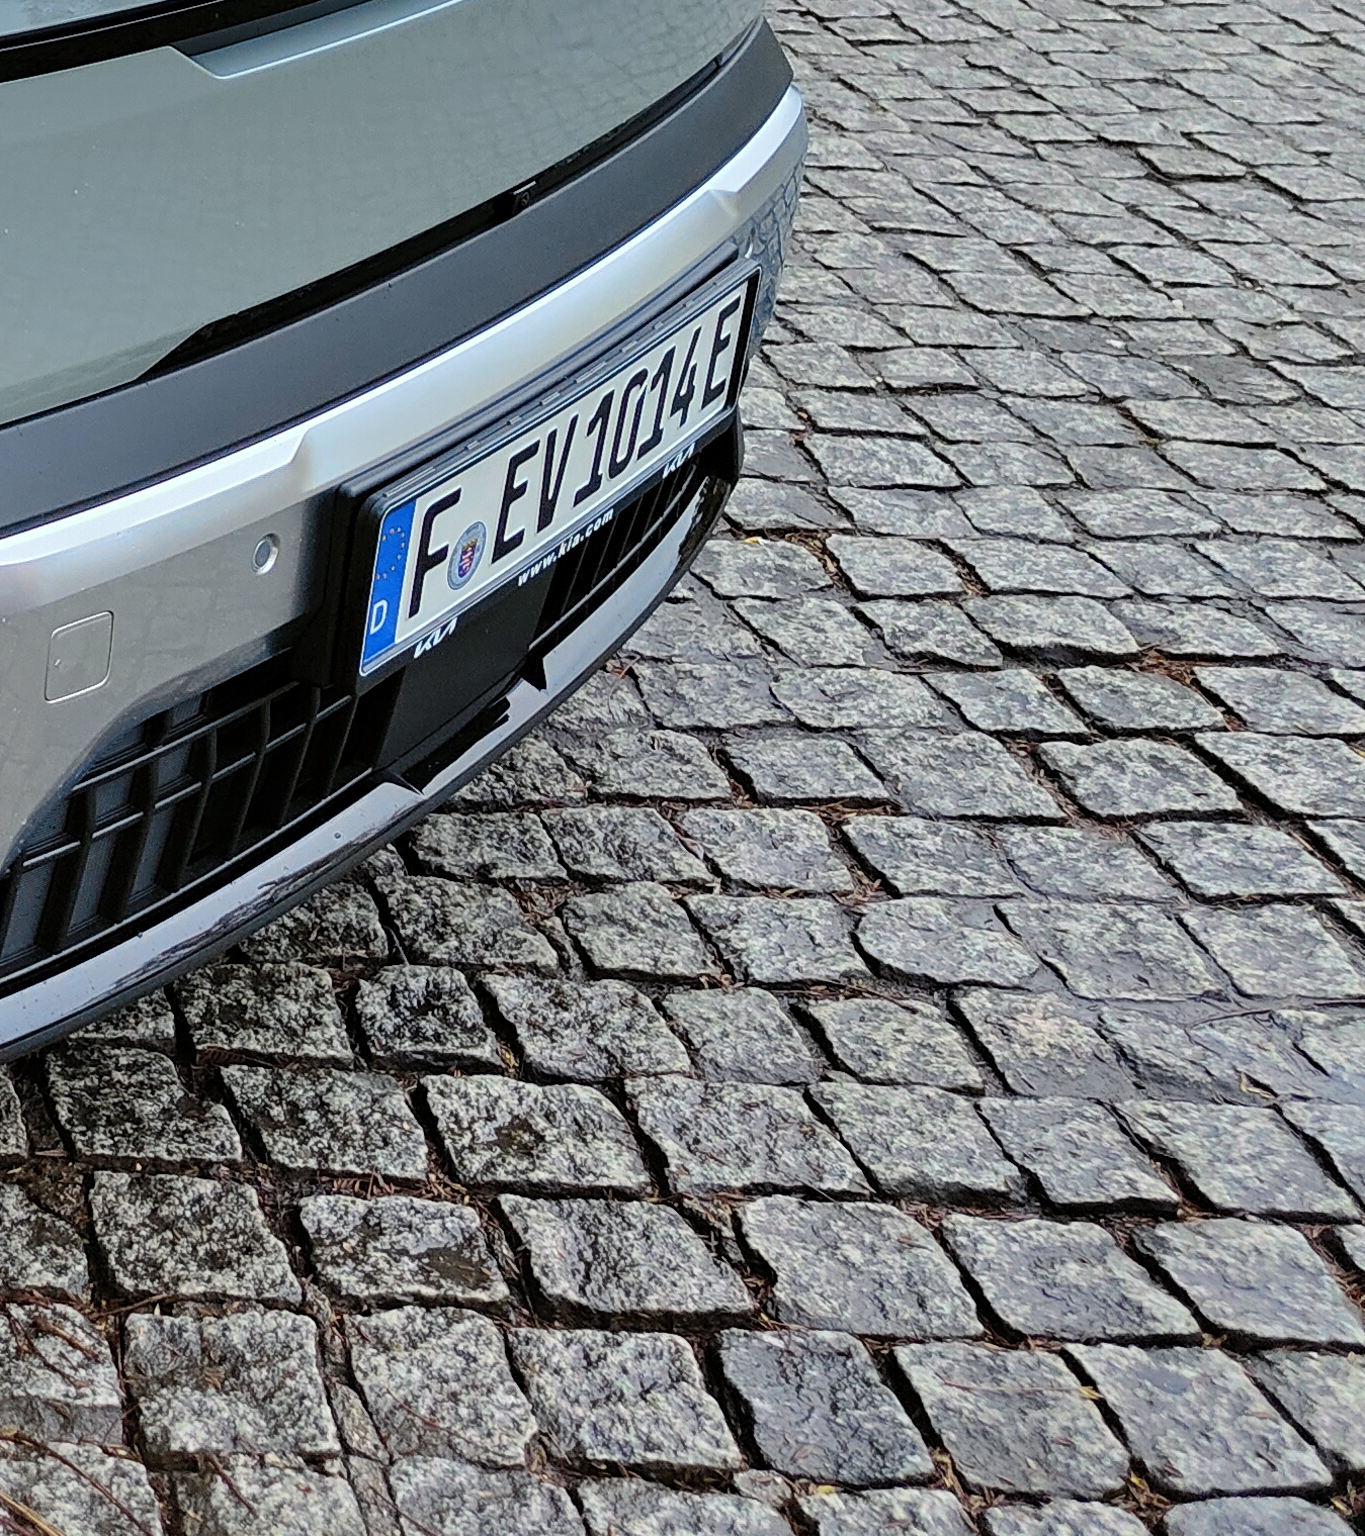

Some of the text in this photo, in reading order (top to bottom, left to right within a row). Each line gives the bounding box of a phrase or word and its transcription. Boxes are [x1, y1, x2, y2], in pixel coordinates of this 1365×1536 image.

[408, 487, 462, 619] F
[518, 509, 614, 586] www.kia.com
[370, 600, 388, 635] D
